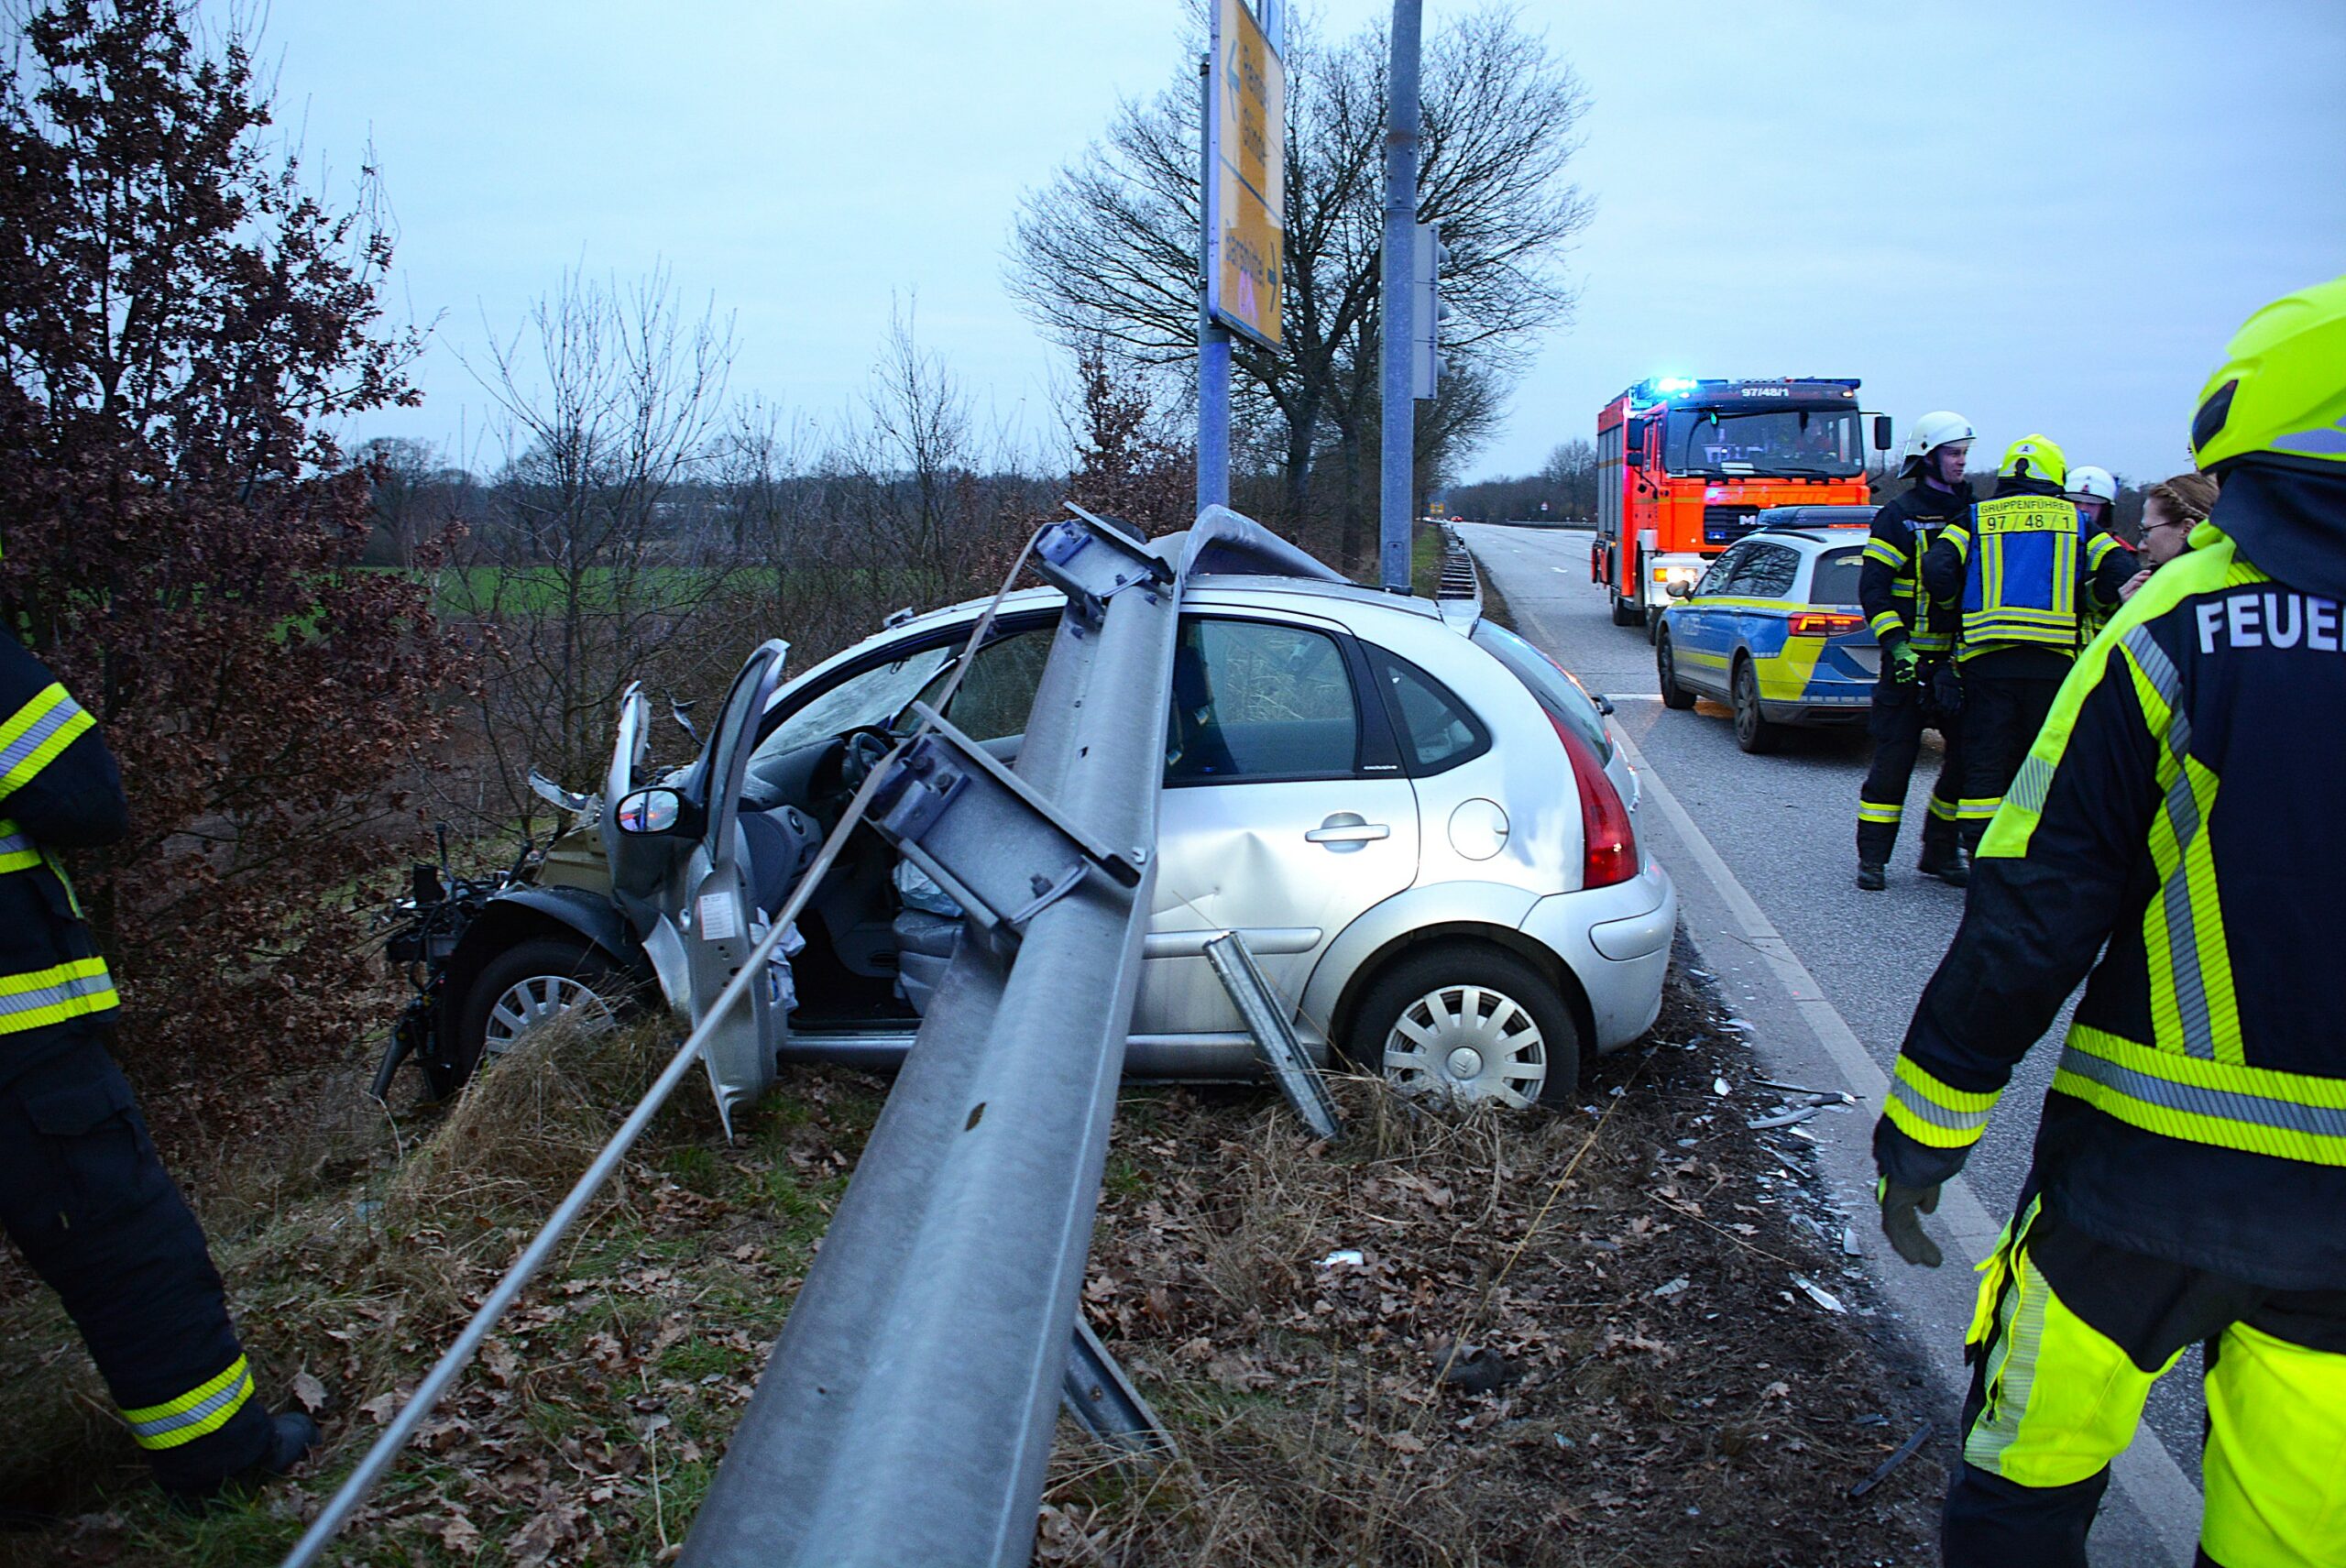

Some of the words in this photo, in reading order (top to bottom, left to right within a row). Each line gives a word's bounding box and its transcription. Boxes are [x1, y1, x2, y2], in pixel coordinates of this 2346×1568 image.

[1741, 388, 1789, 397] 97/48/1
[1987, 516, 2006, 531] 97
[2024, 514, 2044, 529] 48
[2062, 516, 2069, 529] 1
[2196, 593, 2346, 653] FEUE
